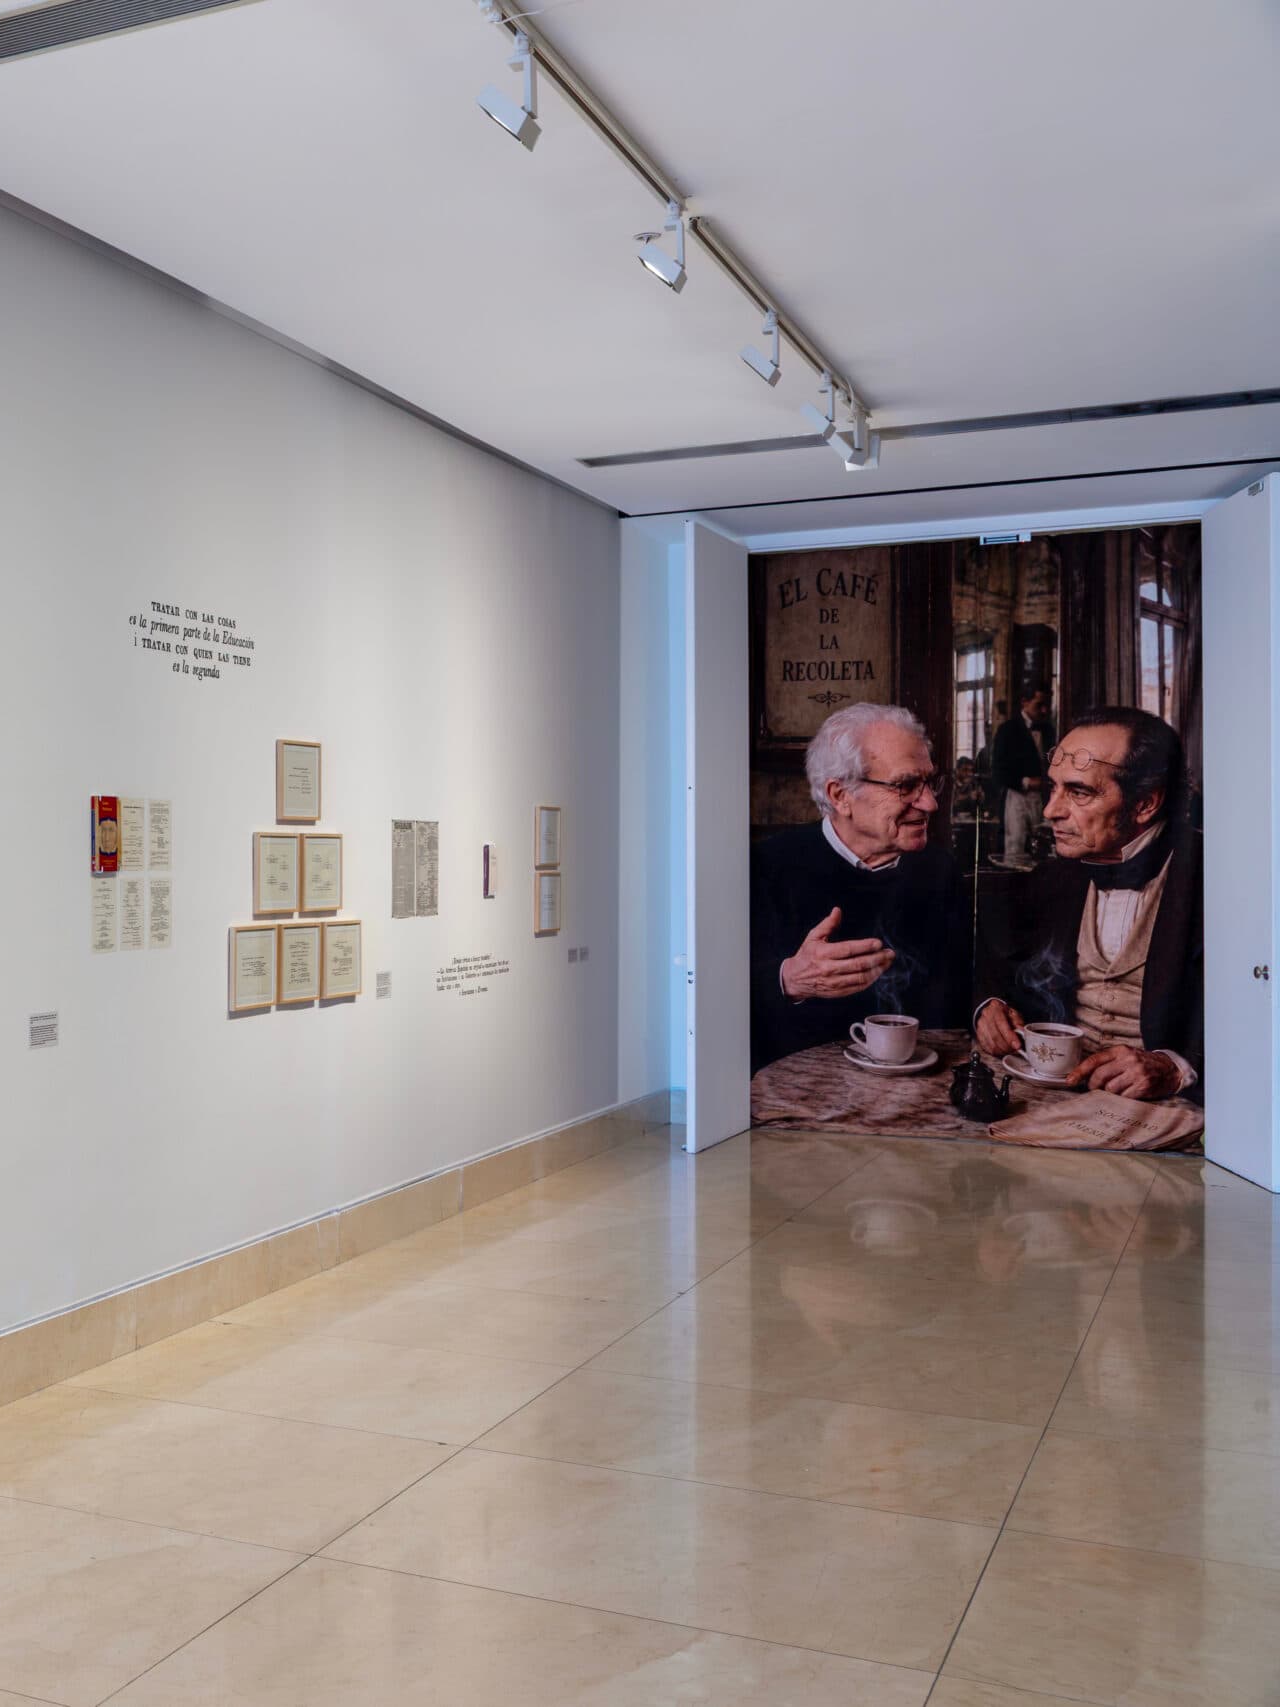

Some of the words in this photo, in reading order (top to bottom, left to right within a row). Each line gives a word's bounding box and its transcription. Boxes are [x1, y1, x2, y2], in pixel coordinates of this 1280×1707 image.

[778, 578, 808, 609] EL
[816, 567, 880, 606] CAFÉ
[151, 601, 180, 617] TRATAR
[185, 609, 198, 620] CON
[202, 613, 214, 624] LAS
[819, 608, 840, 624] DE
[129, 615, 137, 625] es
[139, 614, 147, 629] la
[150, 618, 180, 635] primera
[183, 627, 201, 639] parte
[203, 627, 211, 641] de
[212, 629, 220, 643] la
[222, 630, 254, 650] Educación
[820, 634, 840, 650] LA
[141, 638, 171, 653] TRATAR
[175, 644, 188, 655] CON
[193, 648, 213, 660] QUIEN
[218, 652, 229, 663] LAS
[232, 655, 251, 667] TIENE
[172, 662, 180, 673] es
[182, 660, 189, 674] la
[192, 666, 220, 680] segunda
[783, 661, 875, 681] RECOLETA
